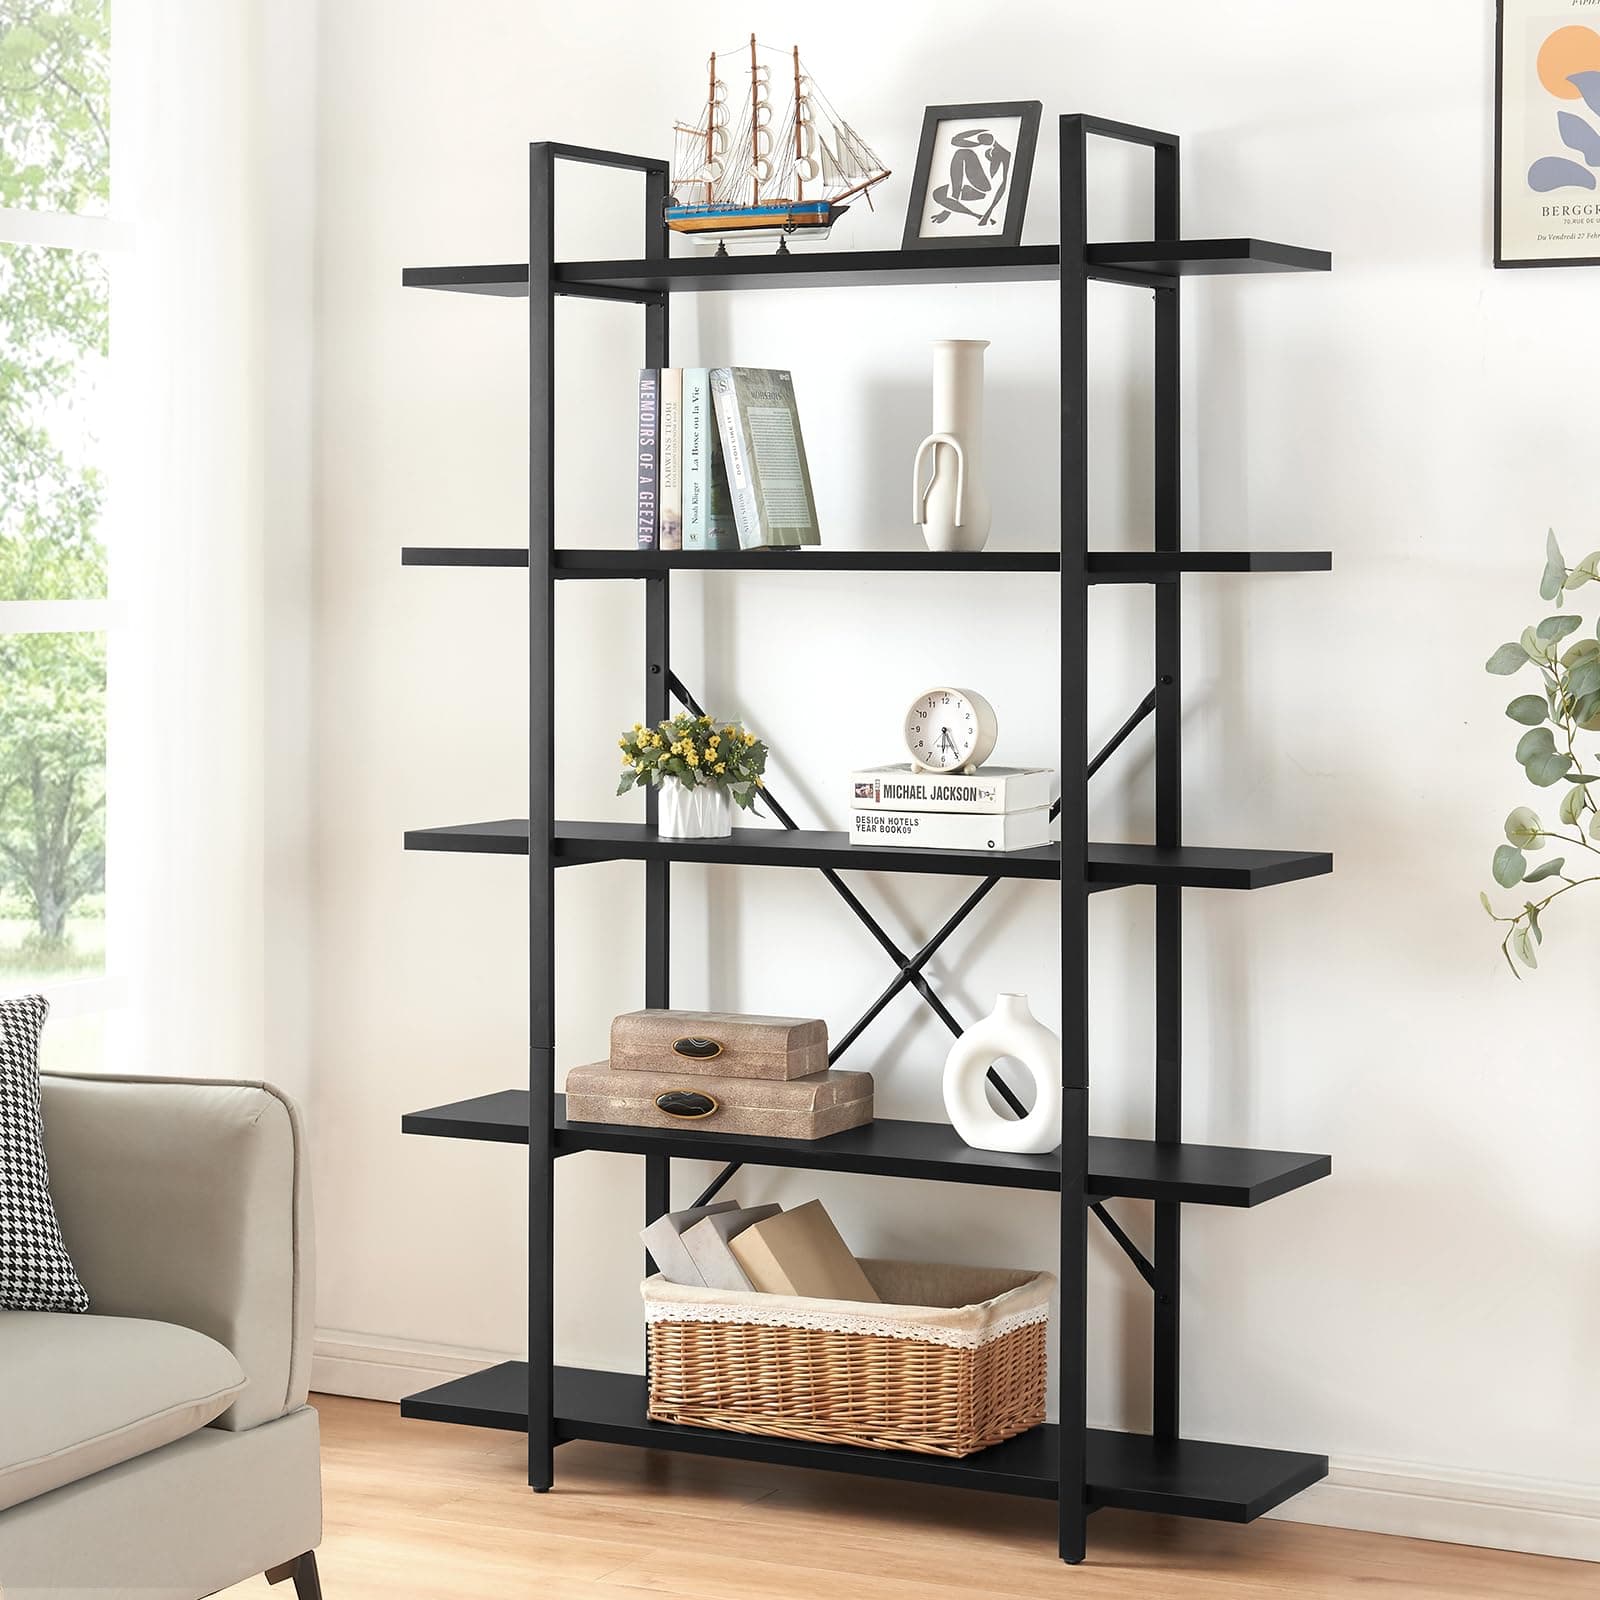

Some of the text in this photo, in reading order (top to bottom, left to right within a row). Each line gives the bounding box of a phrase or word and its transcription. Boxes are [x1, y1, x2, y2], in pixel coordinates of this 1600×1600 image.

[726, 415, 732, 424] IT
[691, 386, 700, 471] La Boxe ou la Vie
[728, 425, 736, 444] LIKE
[664, 402, 672, 488] DARWINS TEORI
[638, 380, 656, 543] MEMOIRS OF A GEEZER
[736, 463, 742, 476] DO
[691, 482, 700, 525] Noah Klieger
[941, 697, 950, 705] 12
[919, 711, 928, 719] 10
[915, 725, 921, 733] 9
[918, 740, 924, 748] 8
[883, 784, 977, 801] MICHAEL JACKSON
[855, 815, 919, 826] DESIGN HOTELS
[855, 824, 877, 833] YEAR
